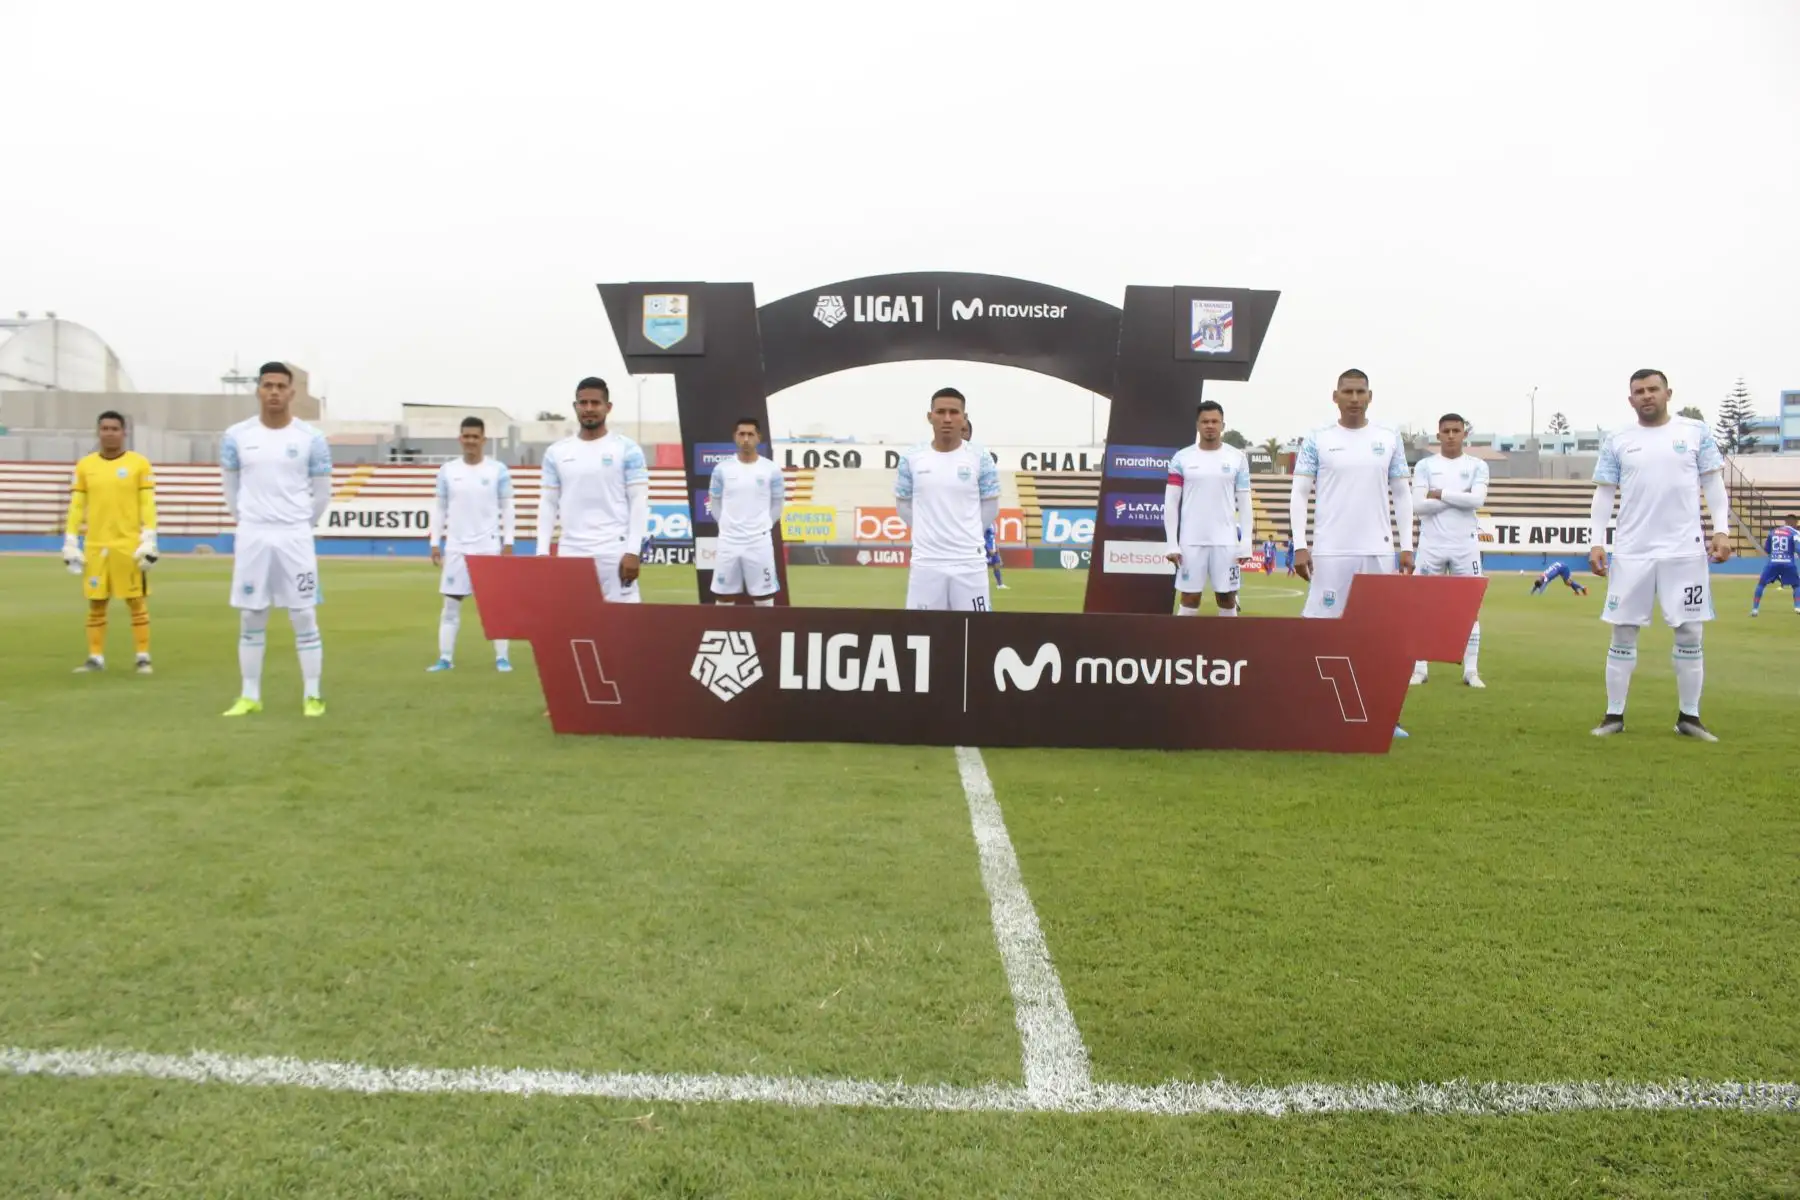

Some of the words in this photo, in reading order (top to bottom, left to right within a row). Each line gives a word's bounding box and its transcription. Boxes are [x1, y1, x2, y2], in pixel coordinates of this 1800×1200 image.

[988, 303, 1068, 319] movistar
[1020, 452, 1104, 471] CHAL
[328, 510, 430, 529] APUESTO
[1495, 525, 1521, 544] TE
[1683, 585, 1704, 606] 32
[1075, 654, 1248, 686] movistar
